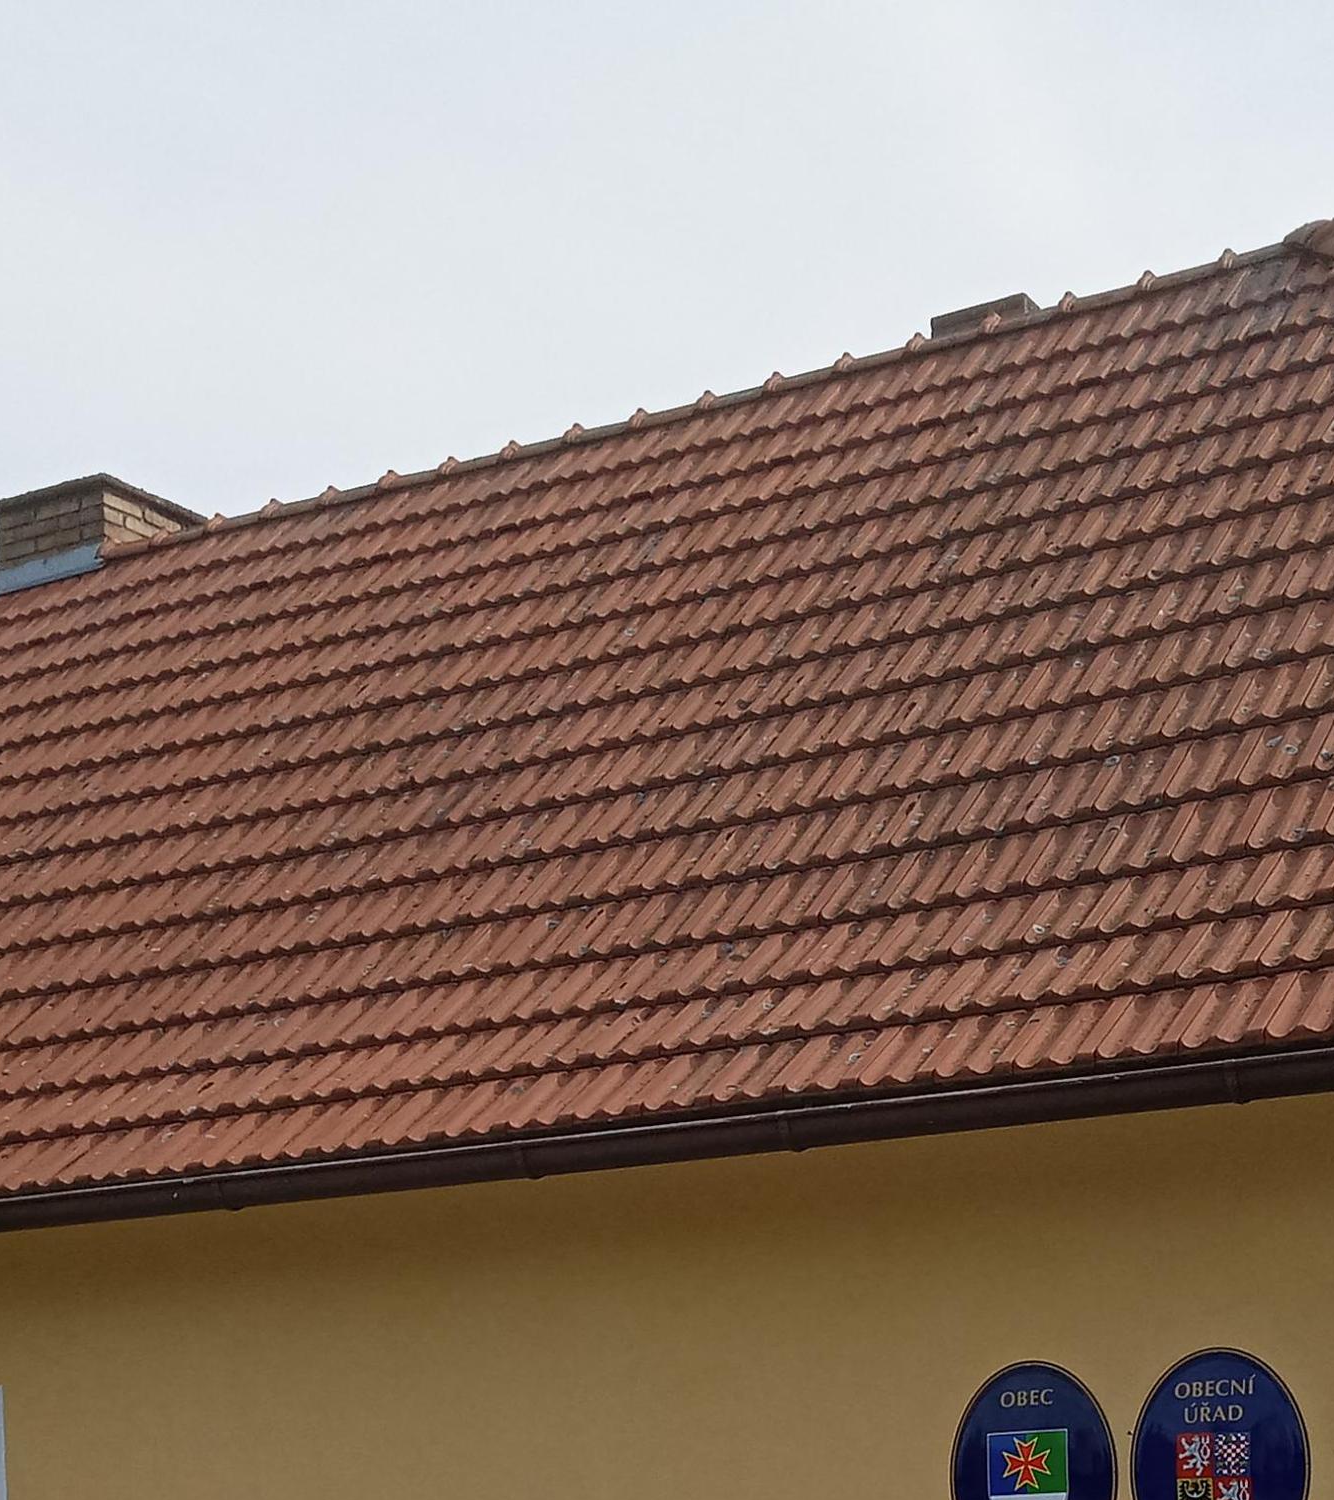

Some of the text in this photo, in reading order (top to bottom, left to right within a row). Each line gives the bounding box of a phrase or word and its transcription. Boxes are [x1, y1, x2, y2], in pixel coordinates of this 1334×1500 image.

[1174, 1374, 1256, 1400] OBECNÍ
[1000, 1388, 1054, 1409] OBEC
[1184, 1402, 1244, 1424] ÚŘAD
